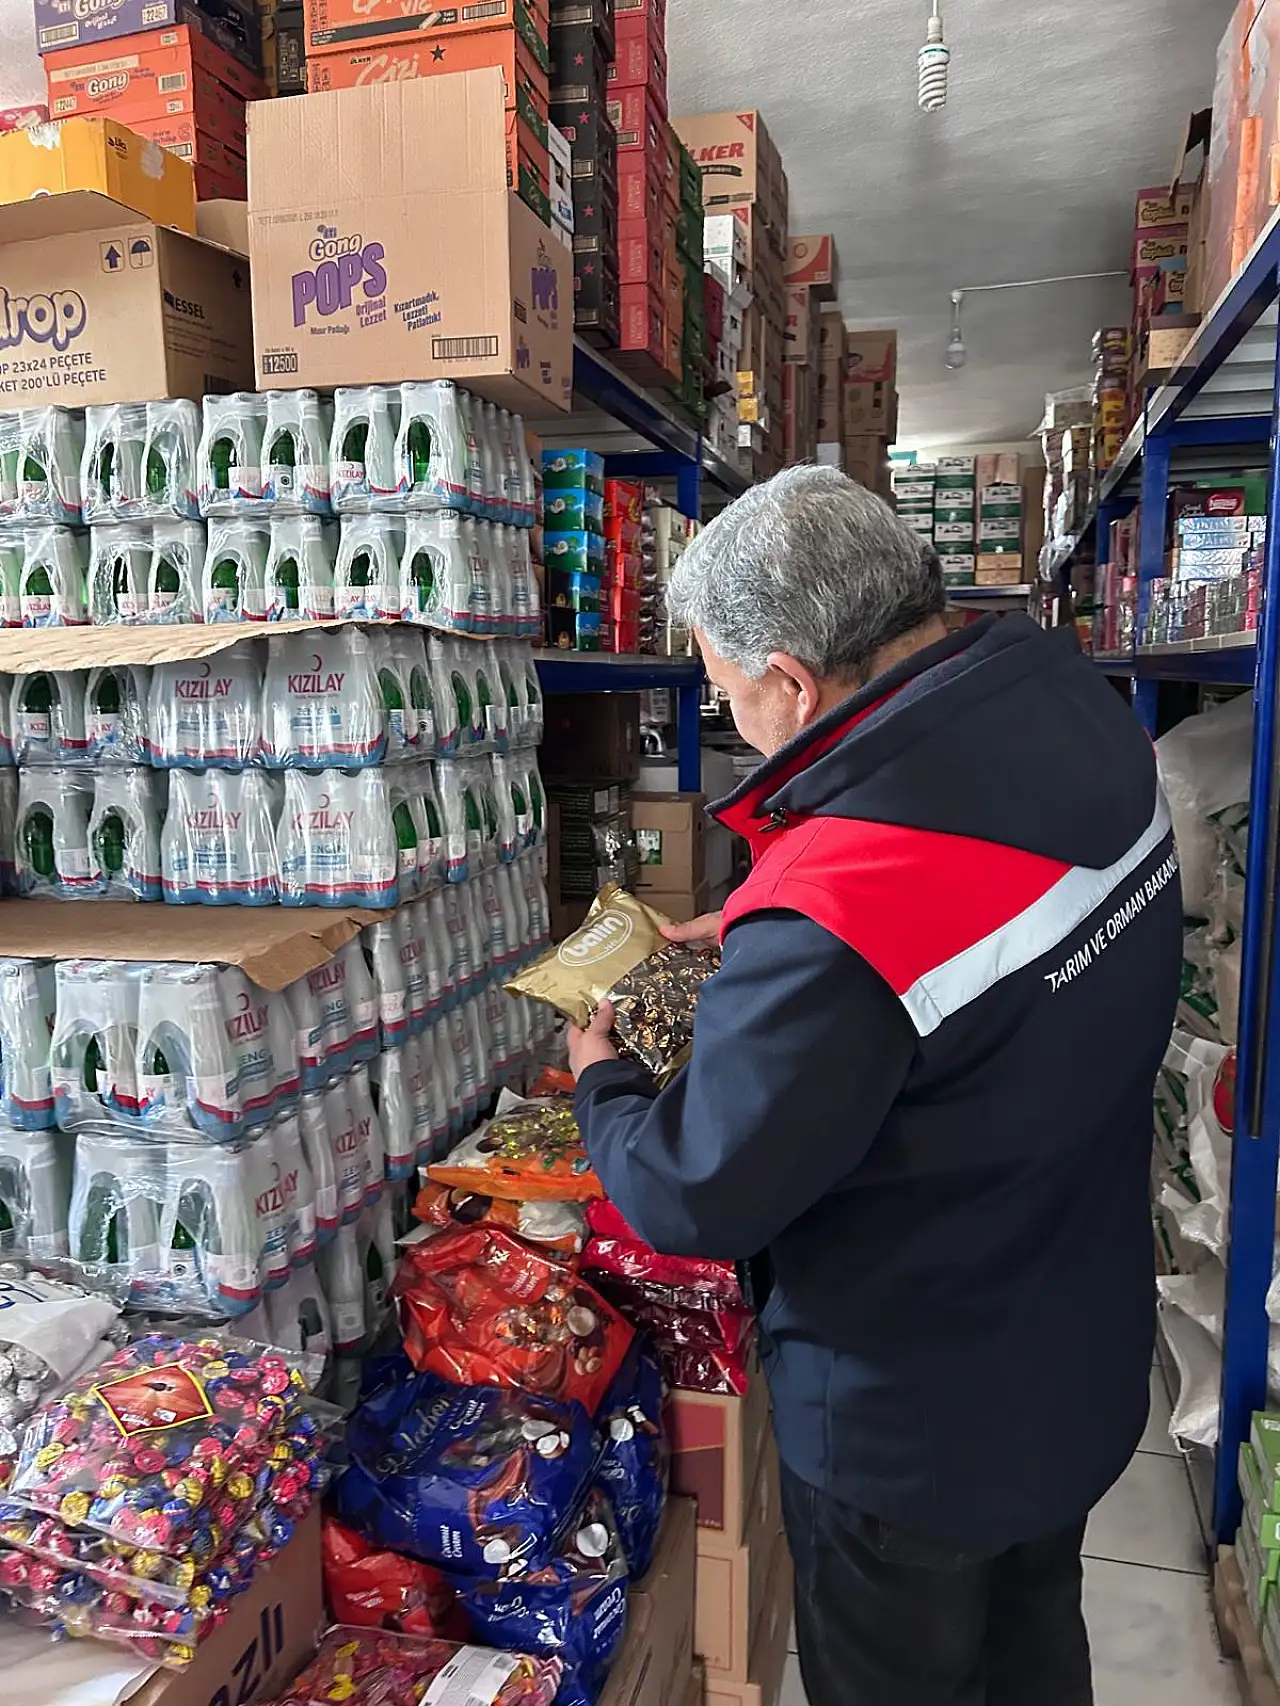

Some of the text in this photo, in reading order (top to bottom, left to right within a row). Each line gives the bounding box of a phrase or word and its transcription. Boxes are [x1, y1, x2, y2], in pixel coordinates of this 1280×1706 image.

[87, 71, 129, 99] Gong
[684, 143, 744, 161] LKER
[309, 234, 362, 262] Gong
[291, 241, 388, 328] POPS
[175, 298, 206, 320] ESSEL
[403, 305, 429, 322] Lezzeti
[360, 312, 387, 329] Lezzet
[0, 352, 92, 374] P 23x24 PEÇETE
[268, 355, 297, 372] 12500
[21, 372, 60, 390] 200'LÜ
[63, 369, 106, 387] PEÇETE
[174, 679, 233, 698] KIZILAY
[288, 673, 345, 693] KIZILAY
[292, 810, 354, 829] KIZILAY
[1044, 943, 1093, 993] TARIM
[1090, 927, 1108, 956] VE
[1106, 887, 1147, 940] ORMAN
